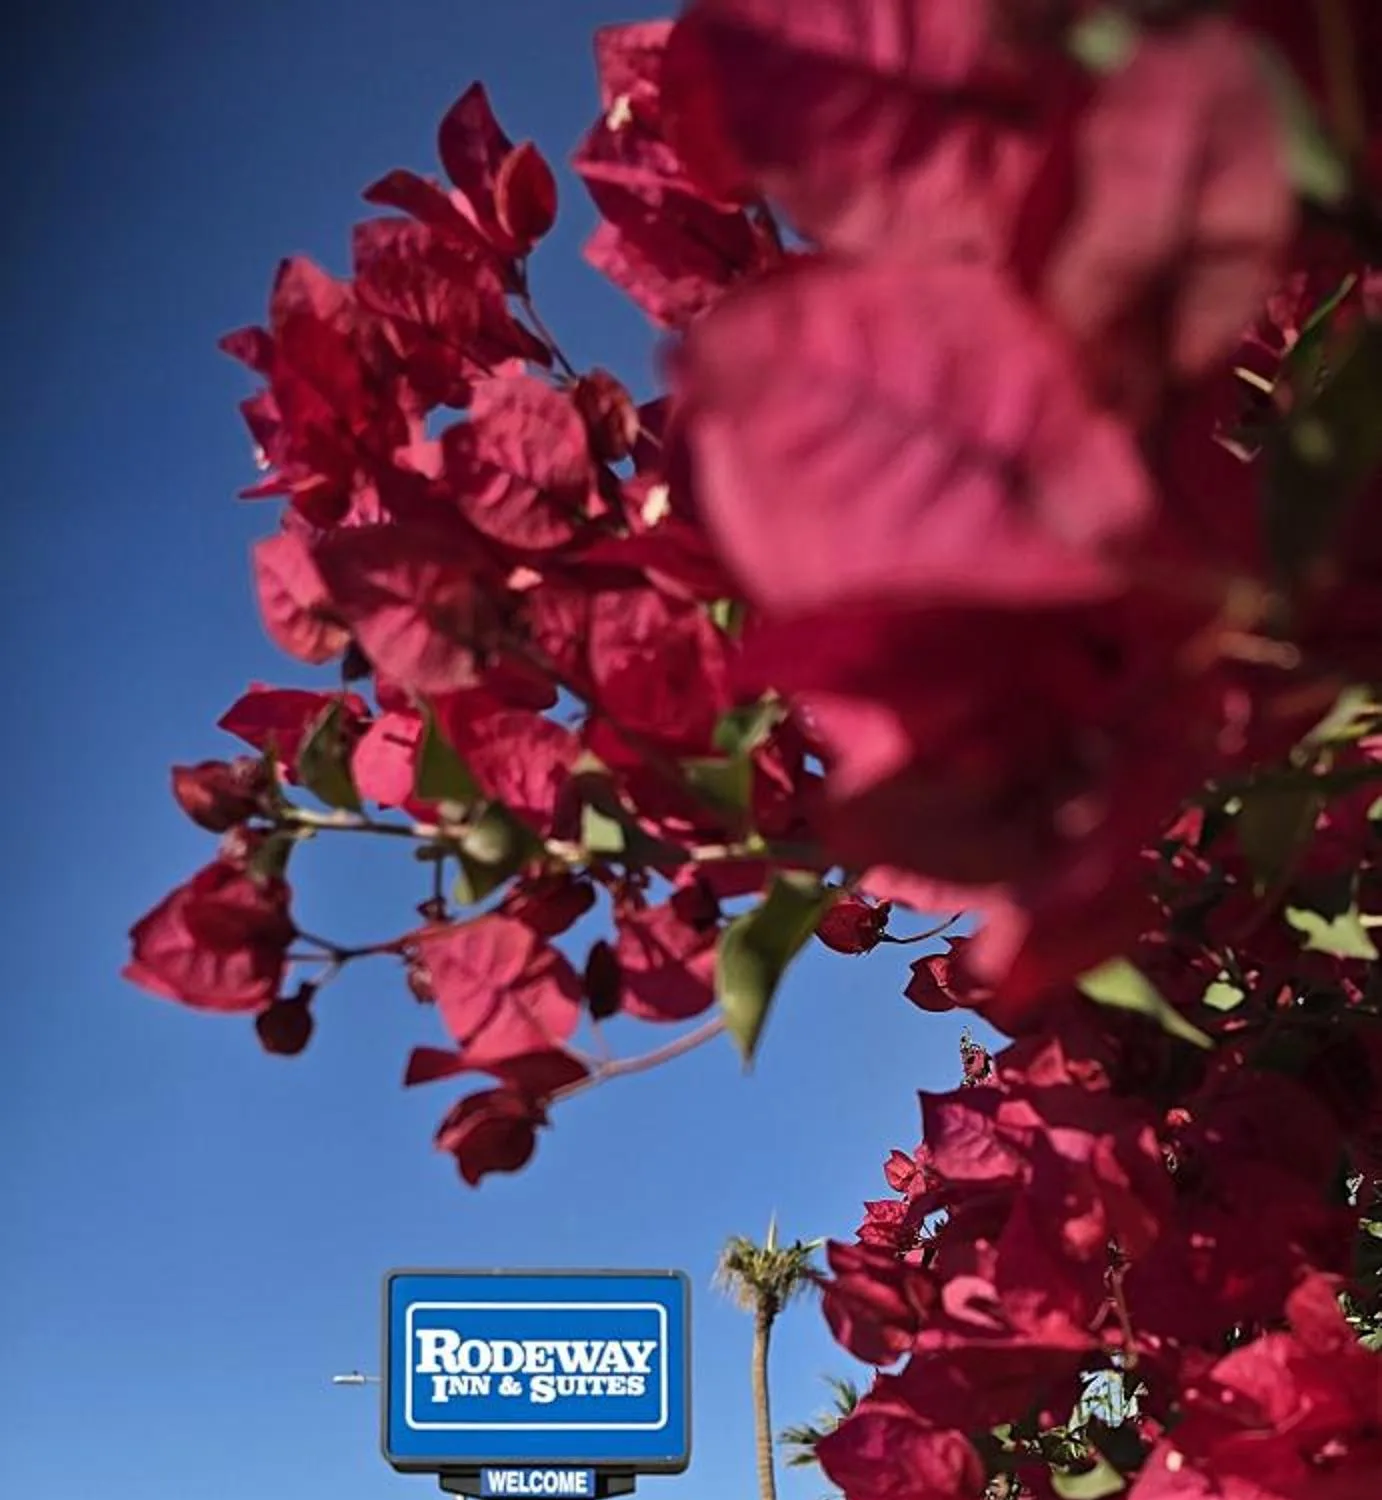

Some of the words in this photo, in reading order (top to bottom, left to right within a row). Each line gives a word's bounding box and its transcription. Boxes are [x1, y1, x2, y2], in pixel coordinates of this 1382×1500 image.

[415, 1329, 657, 1373] RODEWAY
[432, 1376, 490, 1403] INN
[499, 1376, 523, 1396] &
[530, 1376, 645, 1403] SUITES
[487, 1470, 588, 1494] WELCOME
